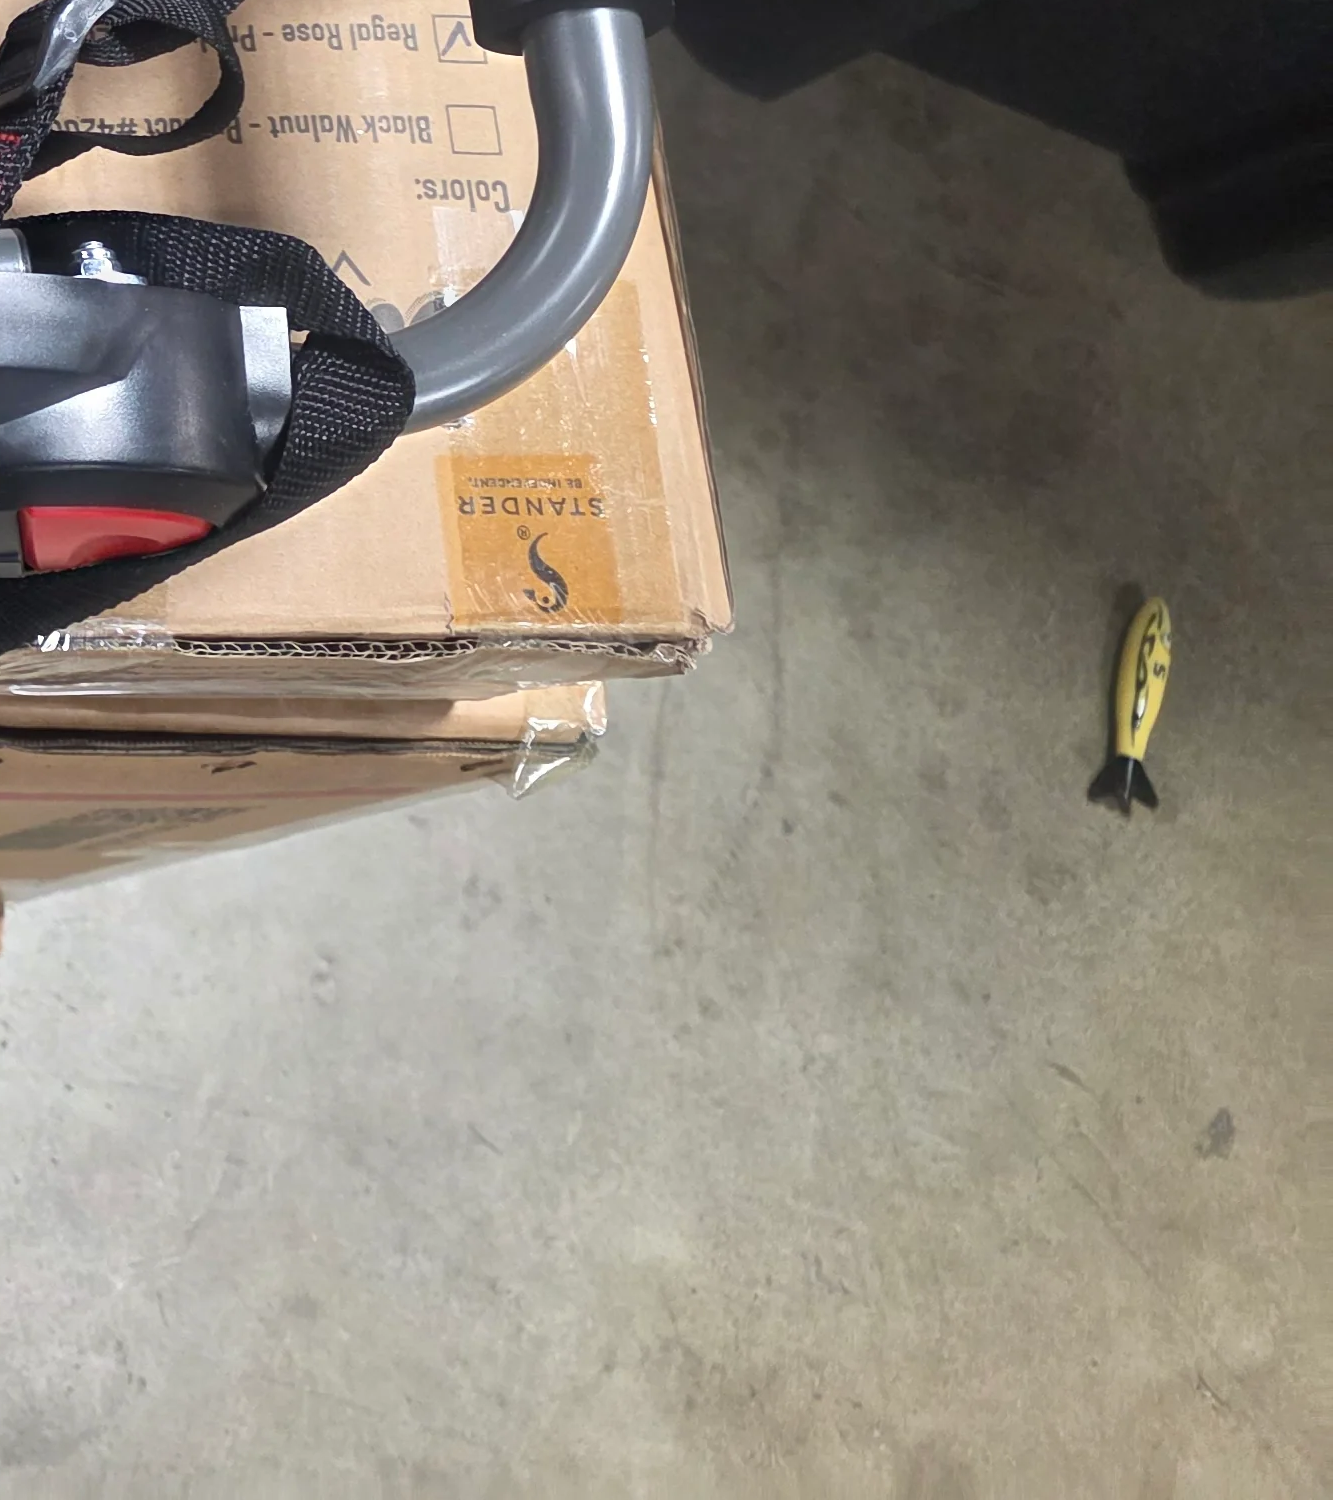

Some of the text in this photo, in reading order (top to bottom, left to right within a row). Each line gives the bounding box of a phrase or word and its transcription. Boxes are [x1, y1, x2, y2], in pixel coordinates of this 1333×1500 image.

[280, 22, 340, 50] Rose
[348, 13, 417, 51] Regal
[265, 114, 356, 143] Walnut
[361, 113, 432, 144] Black
[413, 177, 508, 212] Colors:
[566, 477, 583, 488] BE
[458, 494, 606, 518] STANDER
